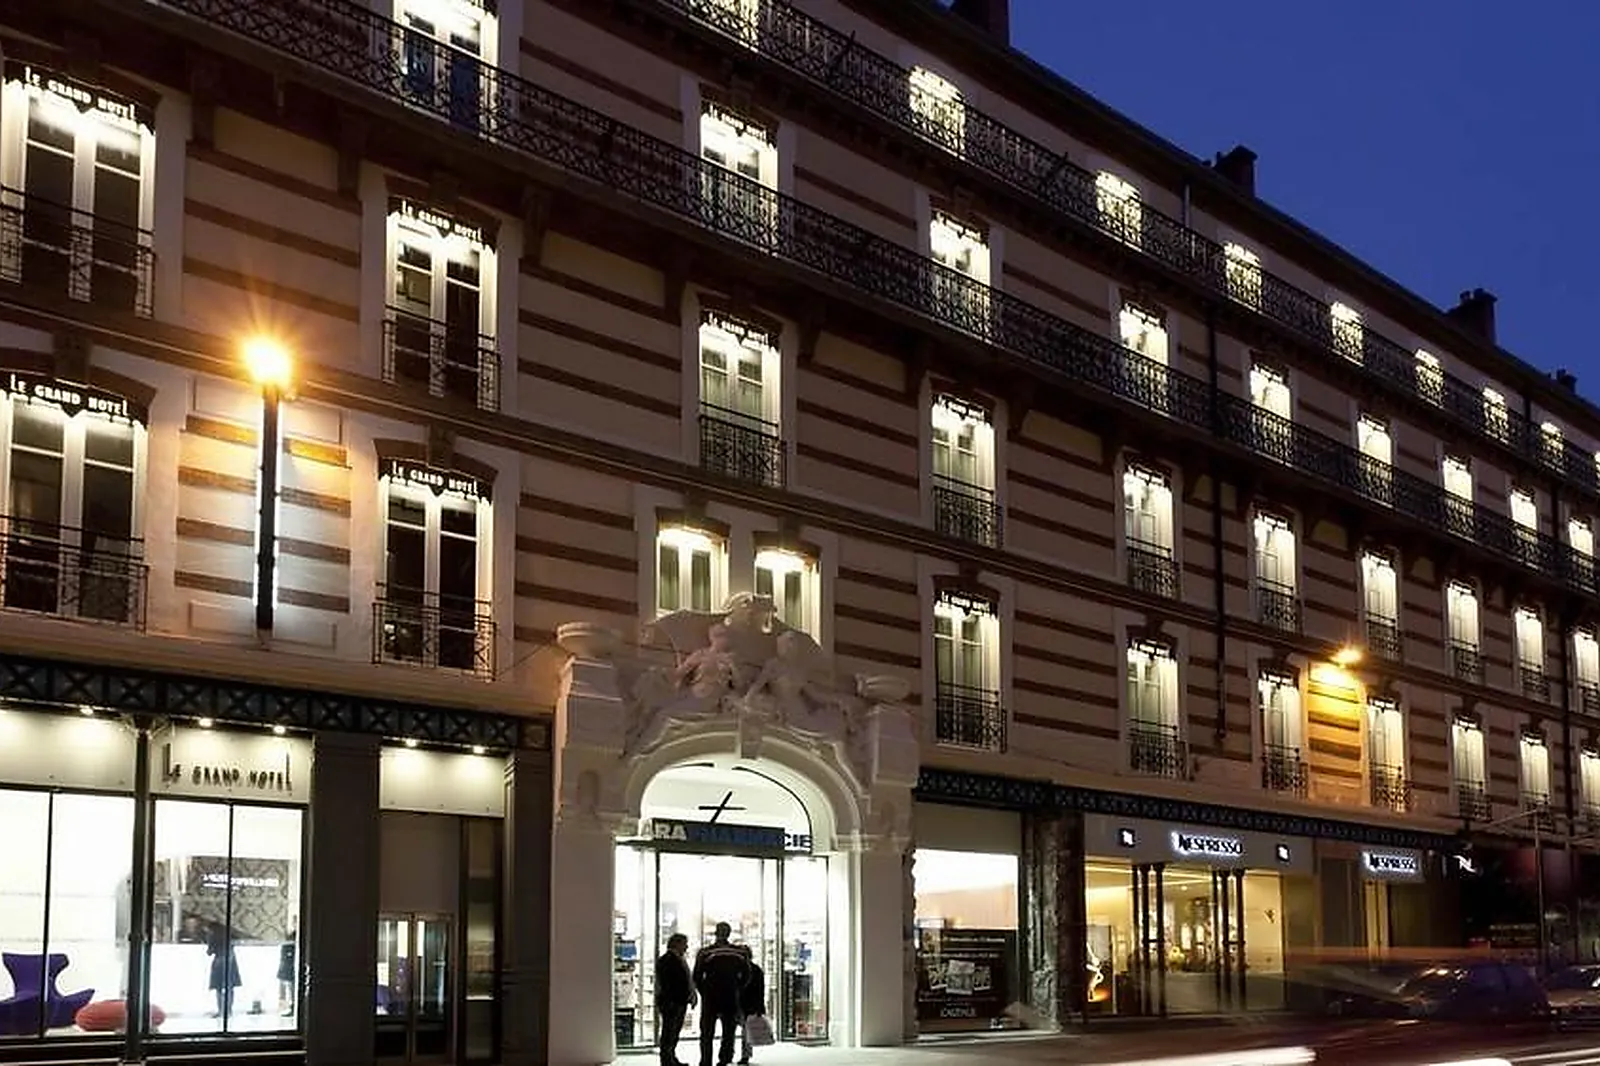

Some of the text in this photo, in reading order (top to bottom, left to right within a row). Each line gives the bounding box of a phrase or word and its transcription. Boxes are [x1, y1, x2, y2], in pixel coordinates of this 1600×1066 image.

[10, 373, 129, 417] LE GRAND HOTEL
[1172, 832, 1243, 855] NESPRESSO
